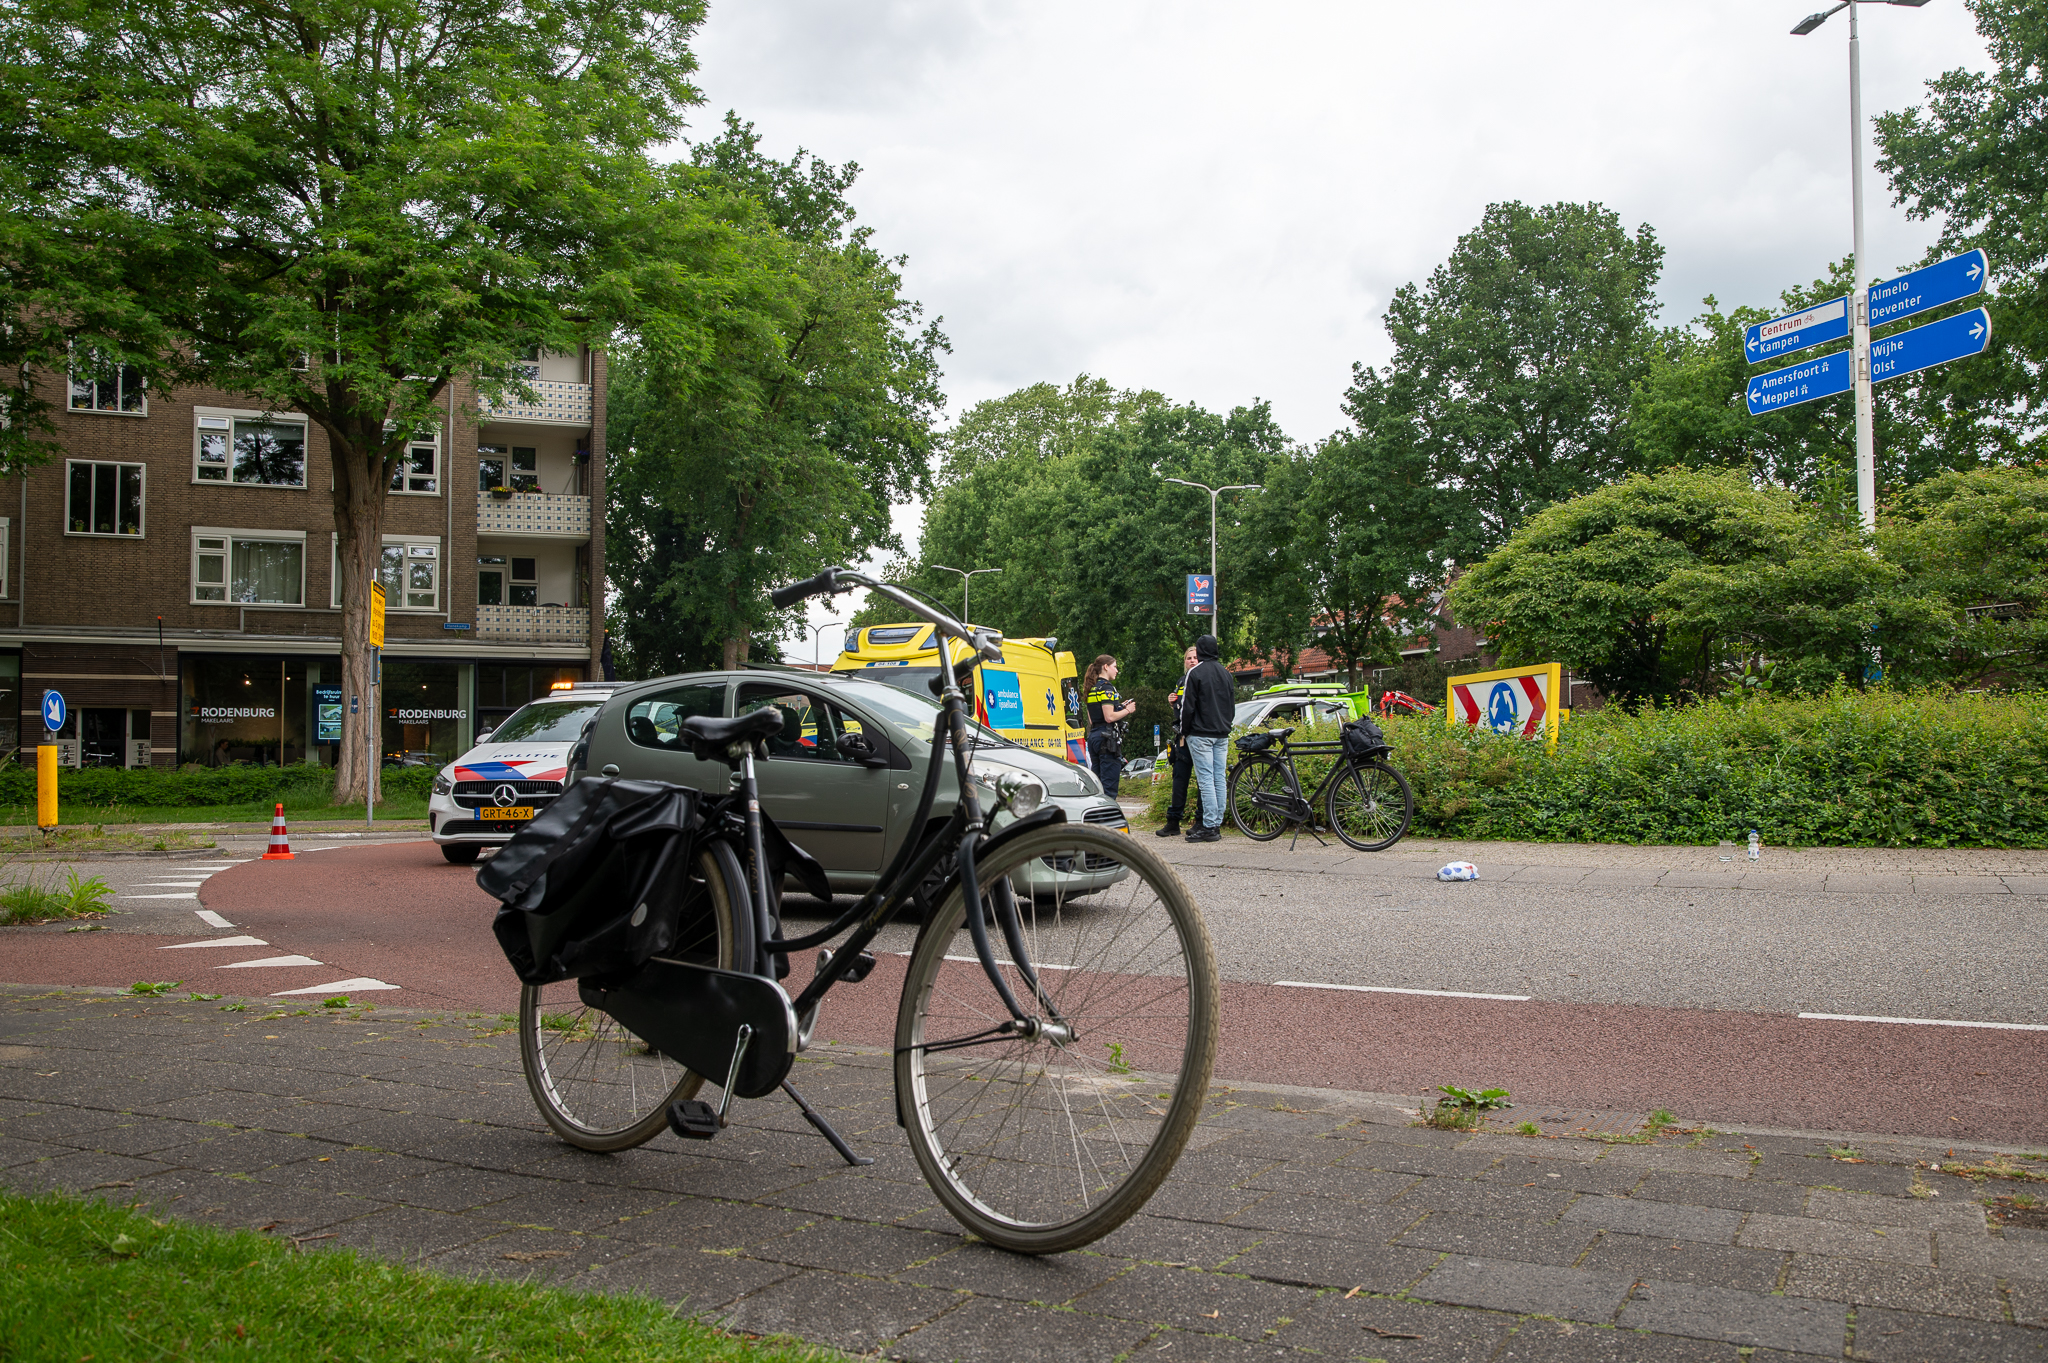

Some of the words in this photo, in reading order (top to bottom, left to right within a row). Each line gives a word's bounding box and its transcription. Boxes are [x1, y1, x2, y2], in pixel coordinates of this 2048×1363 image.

[1870, 282, 1909, 302] Almelo
[1871, 295, 1922, 320] Deventer
[1761, 318, 1802, 337] Centrum
[1760, 335, 1800, 354] Kampen
[1872, 340, 1904, 358] Wijhe
[1873, 360, 1896, 374] Olst
[1762, 364, 1820, 390] Amersfoort
[1762, 386, 1798, 406] Meppel
[998, 689, 1019, 698] ambulance
[201, 707, 275, 718] RODENBURG
[398, 709, 466, 719] RODENBURG
[482, 808, 530, 818] GRT-46-X
